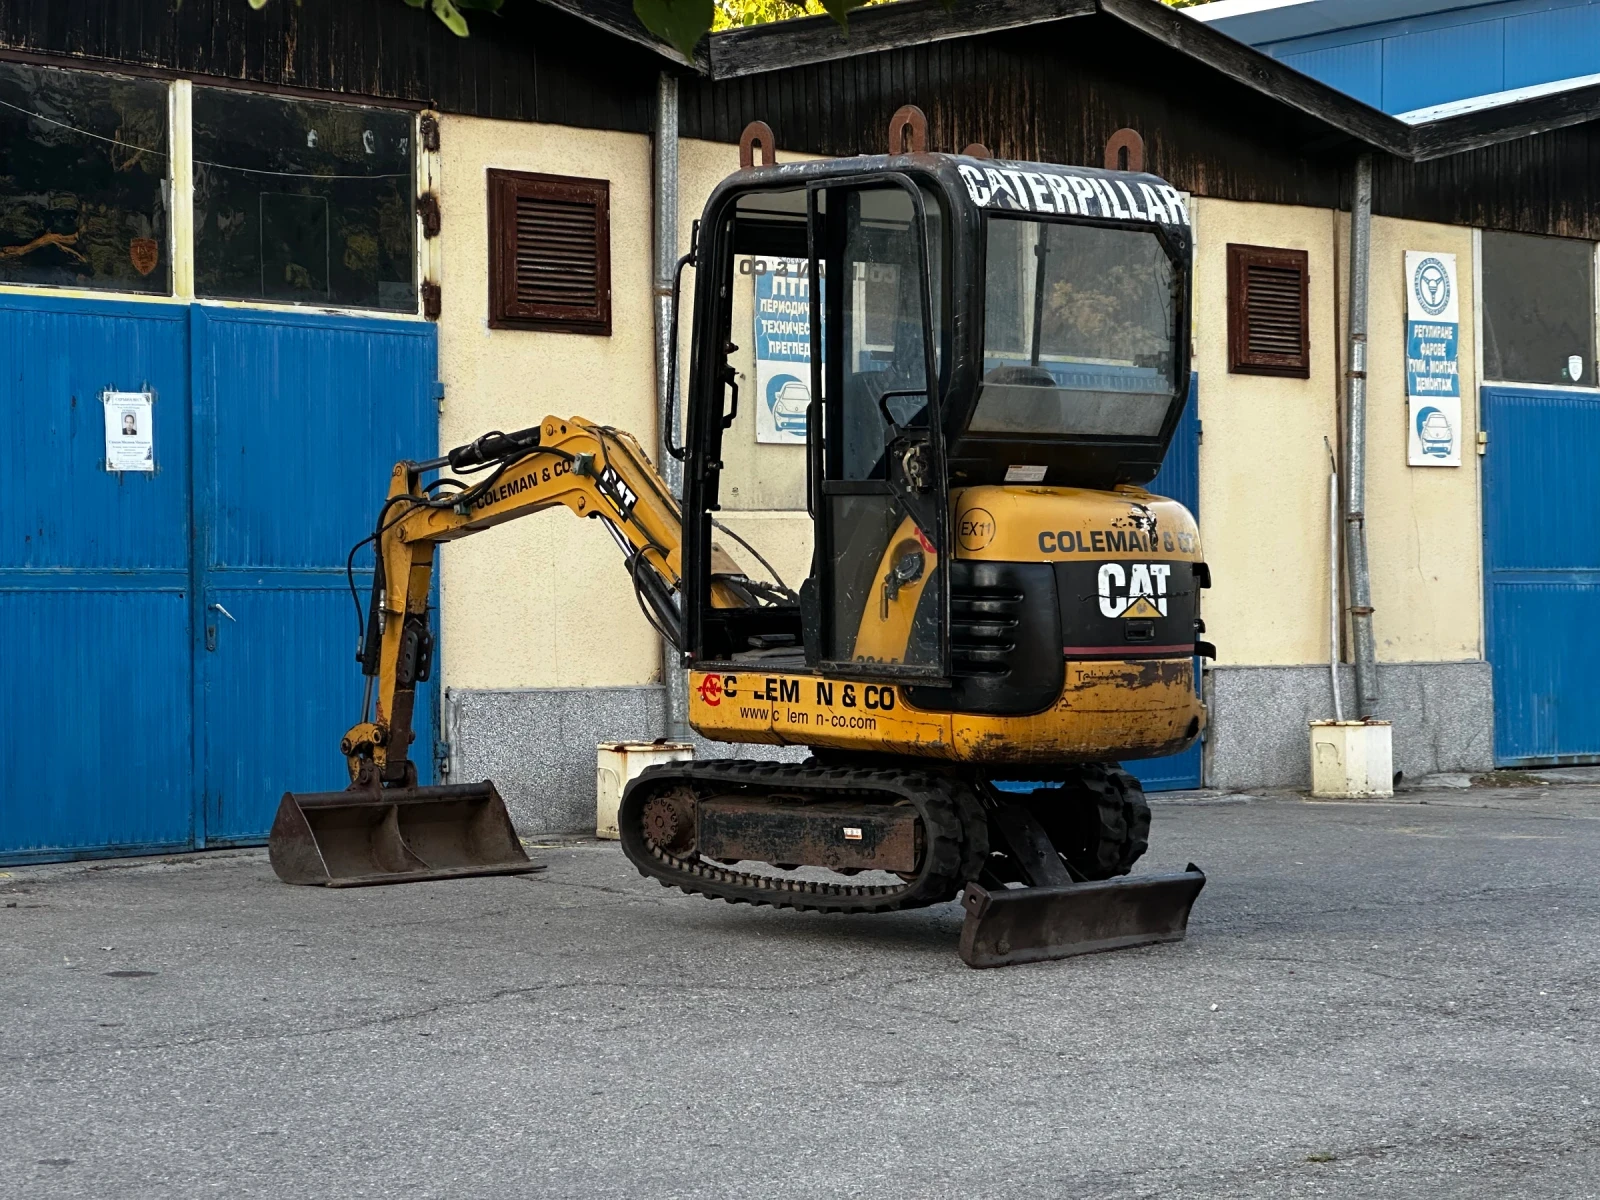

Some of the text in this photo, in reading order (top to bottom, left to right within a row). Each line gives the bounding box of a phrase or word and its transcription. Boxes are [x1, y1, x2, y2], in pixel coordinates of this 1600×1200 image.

[958, 164, 1190, 226] CATERPILLAR
[760, 299, 822, 315] ПЕРИОДИЧ
[762, 320, 810, 335] ТЕХНИЧЕС
[1414, 325, 1453, 339] РЕГУЛИРАНЕ
[769, 341, 810, 357] ПРЕГЛЕД
[1421, 343, 1446, 356] ФАРОВЕ
[1409, 359, 1426, 373] ГУМИ
[1430, 360, 1458, 374] МОНТАЖ
[1416, 377, 1453, 392] ДЕМОНТАЖ
[475, 471, 538, 510] COLEMAN
[541, 466, 552, 483] &
[961, 521, 991, 537] EX11
[1097, 563, 1171, 618] CAT
[723, 675, 895, 711] CLEMN & CO
